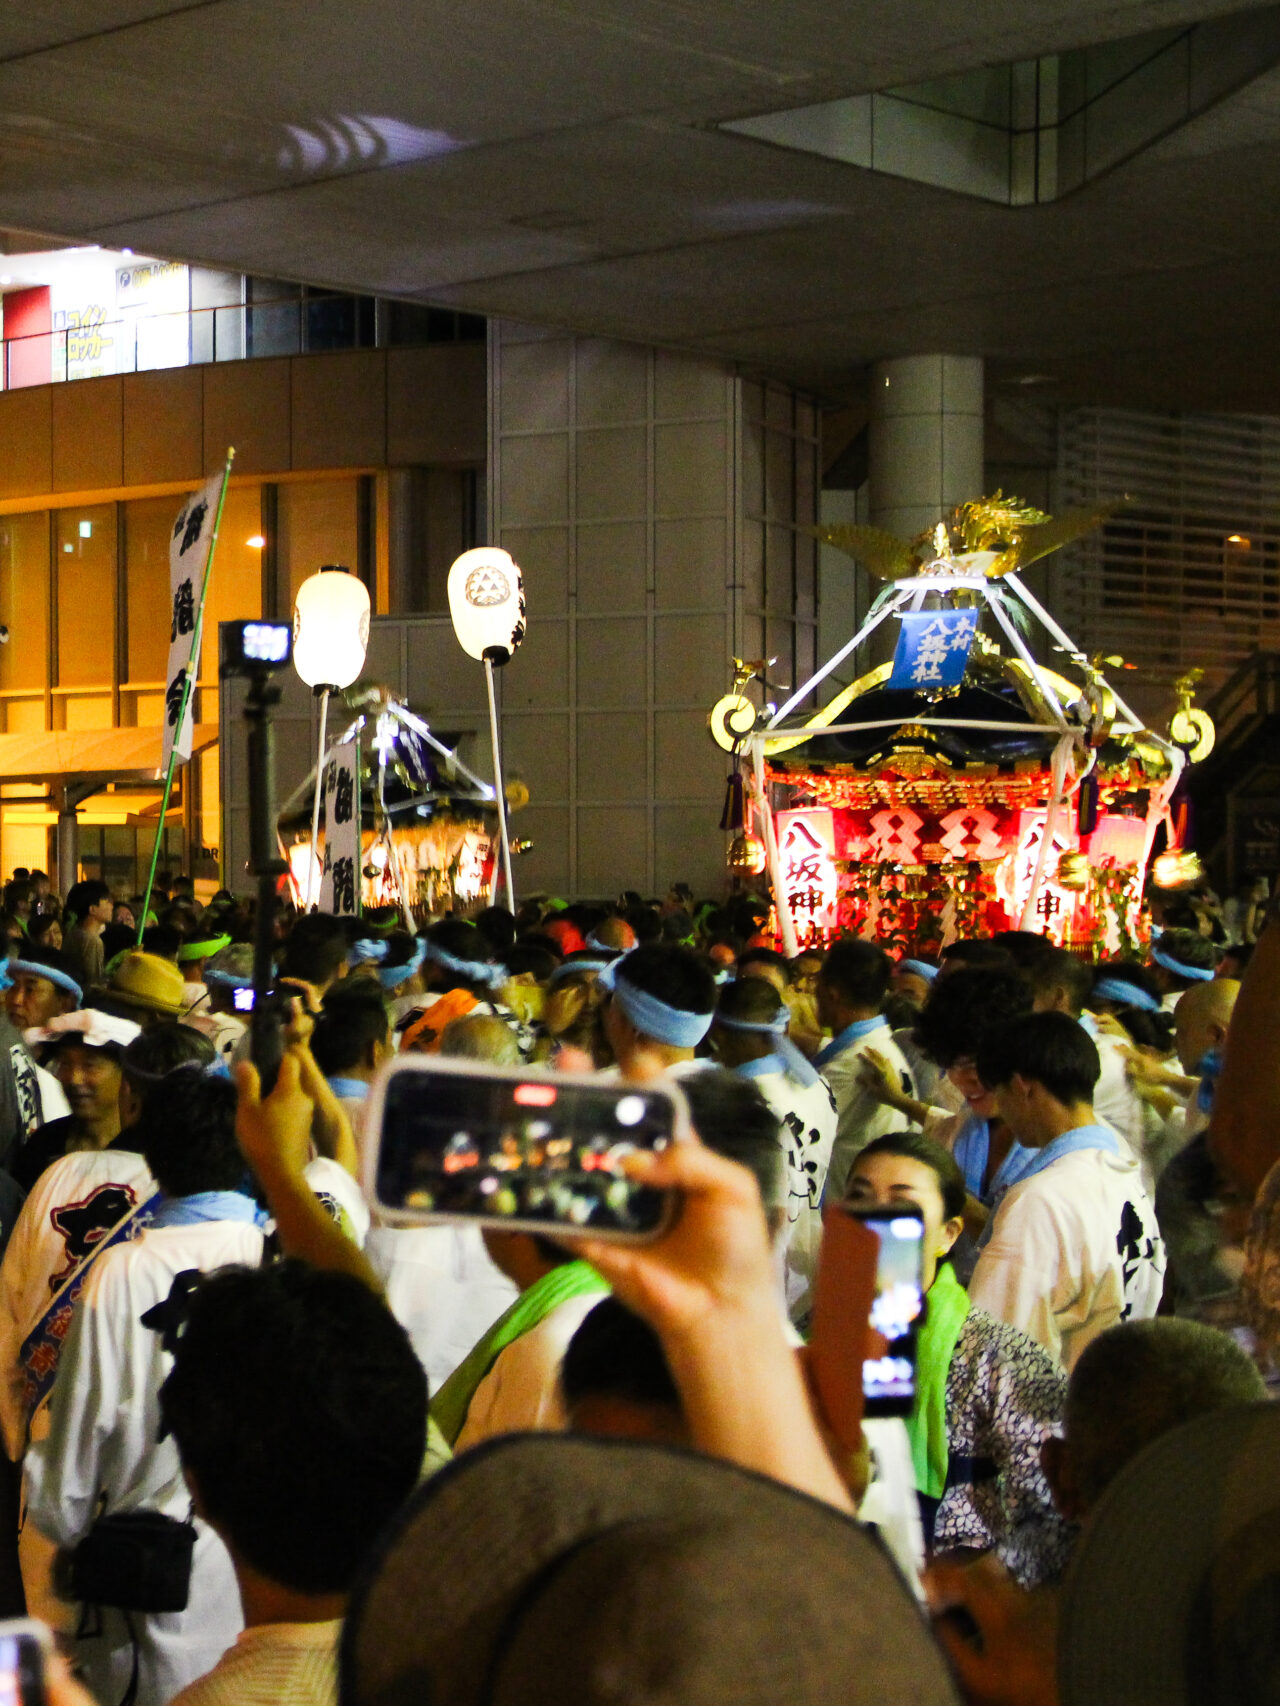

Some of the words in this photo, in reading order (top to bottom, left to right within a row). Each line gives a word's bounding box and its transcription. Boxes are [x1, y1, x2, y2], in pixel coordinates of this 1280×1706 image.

[67, 305, 107, 335] コイン
[67, 324, 113, 361] ロッカー
[910, 618, 955, 683] 八坂神社
[784, 821, 824, 926] 八坂神
